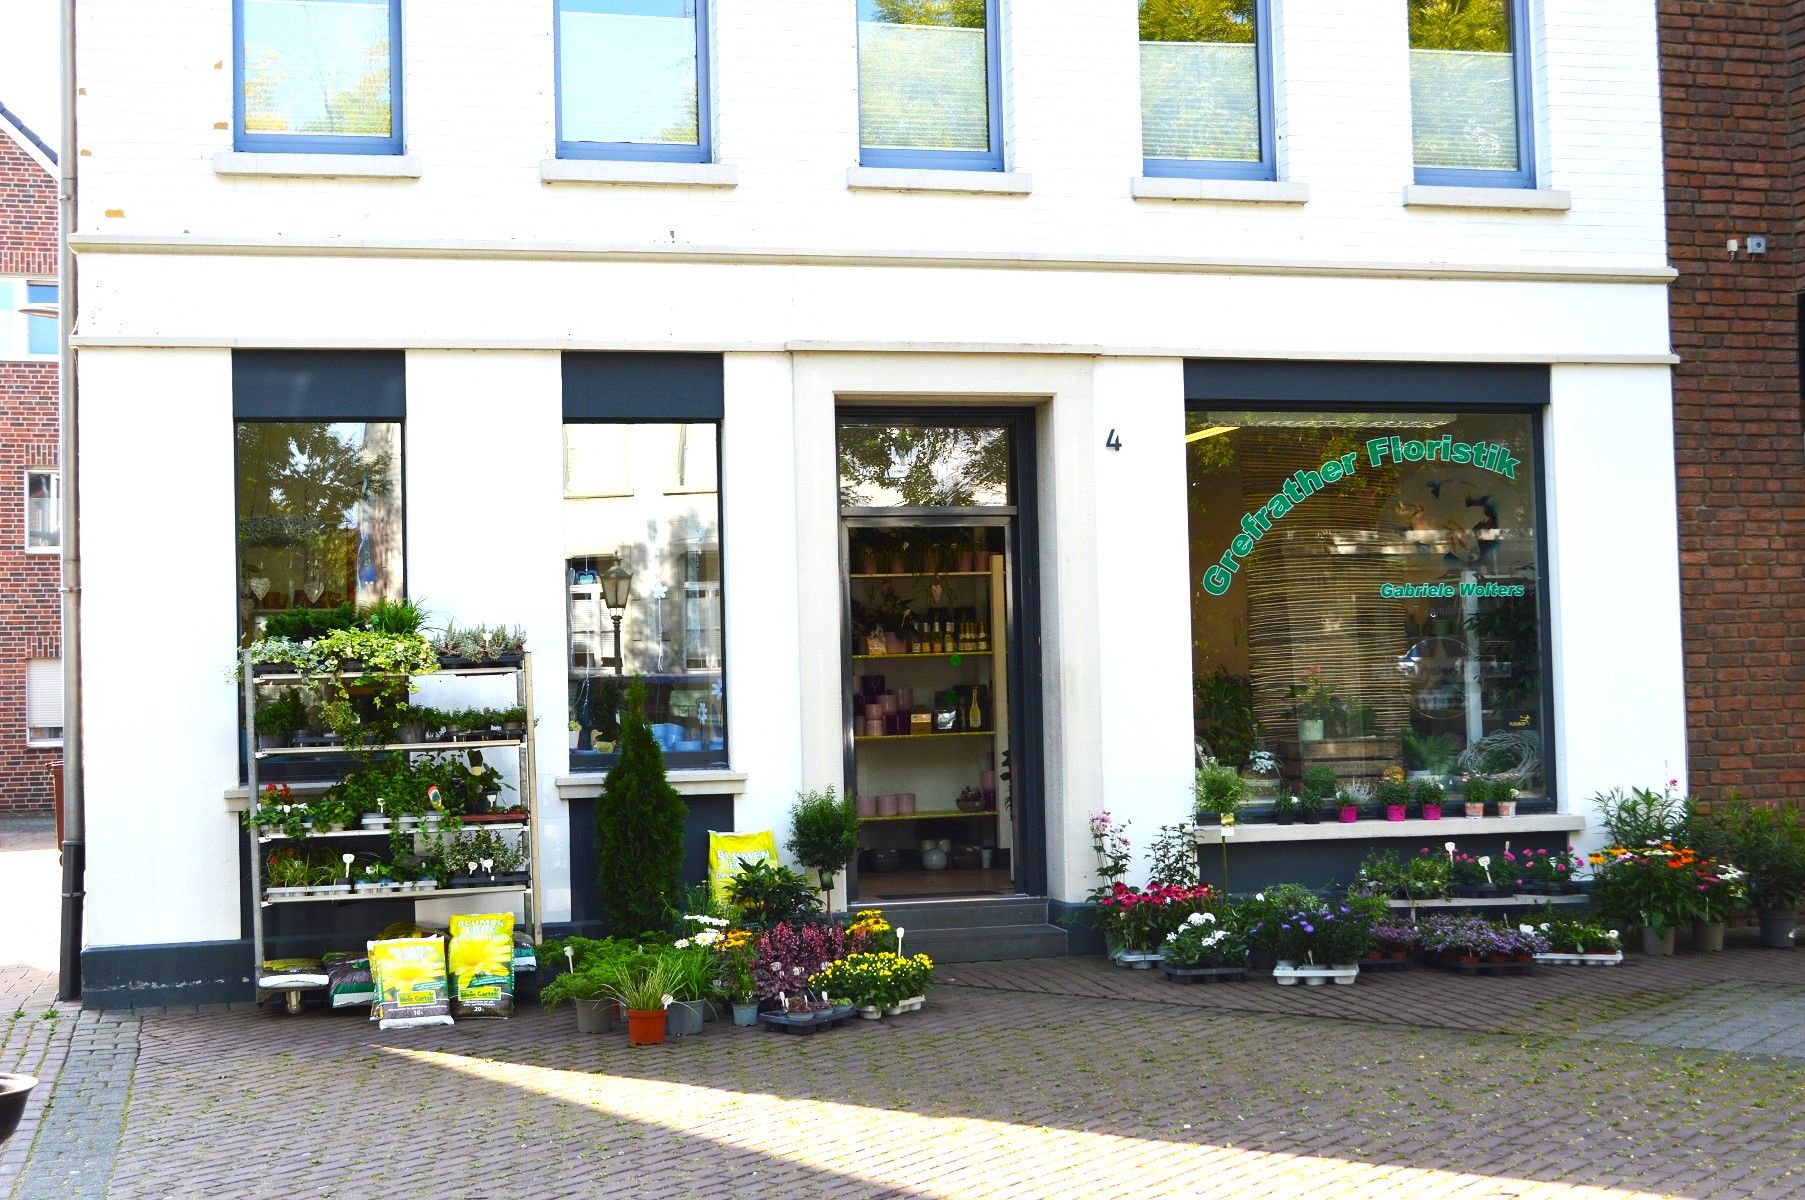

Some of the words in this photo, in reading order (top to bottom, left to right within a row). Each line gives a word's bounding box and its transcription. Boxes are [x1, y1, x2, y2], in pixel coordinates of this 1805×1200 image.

[1105, 428, 1122, 451] 4
[1202, 451, 1357, 596] Grefrather
[1366, 434, 1521, 480] Floristik
[1380, 582, 1455, 598] Gabriele
[1459, 581, 1525, 597] Wolters
